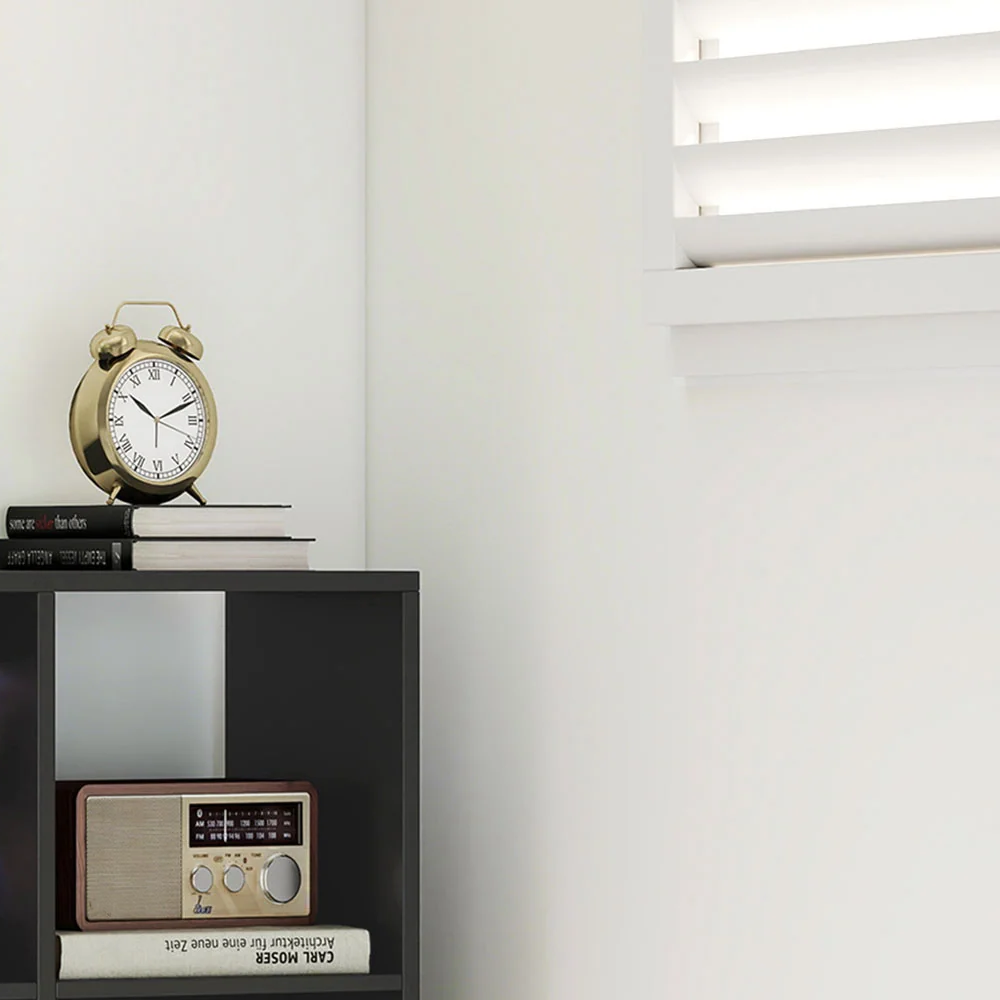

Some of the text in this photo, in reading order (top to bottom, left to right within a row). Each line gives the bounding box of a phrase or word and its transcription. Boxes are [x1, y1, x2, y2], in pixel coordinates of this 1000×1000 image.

[164, 936, 335, 952] Architektur für eine neue Zeit
[256, 951, 335, 964] CARL MOSER
